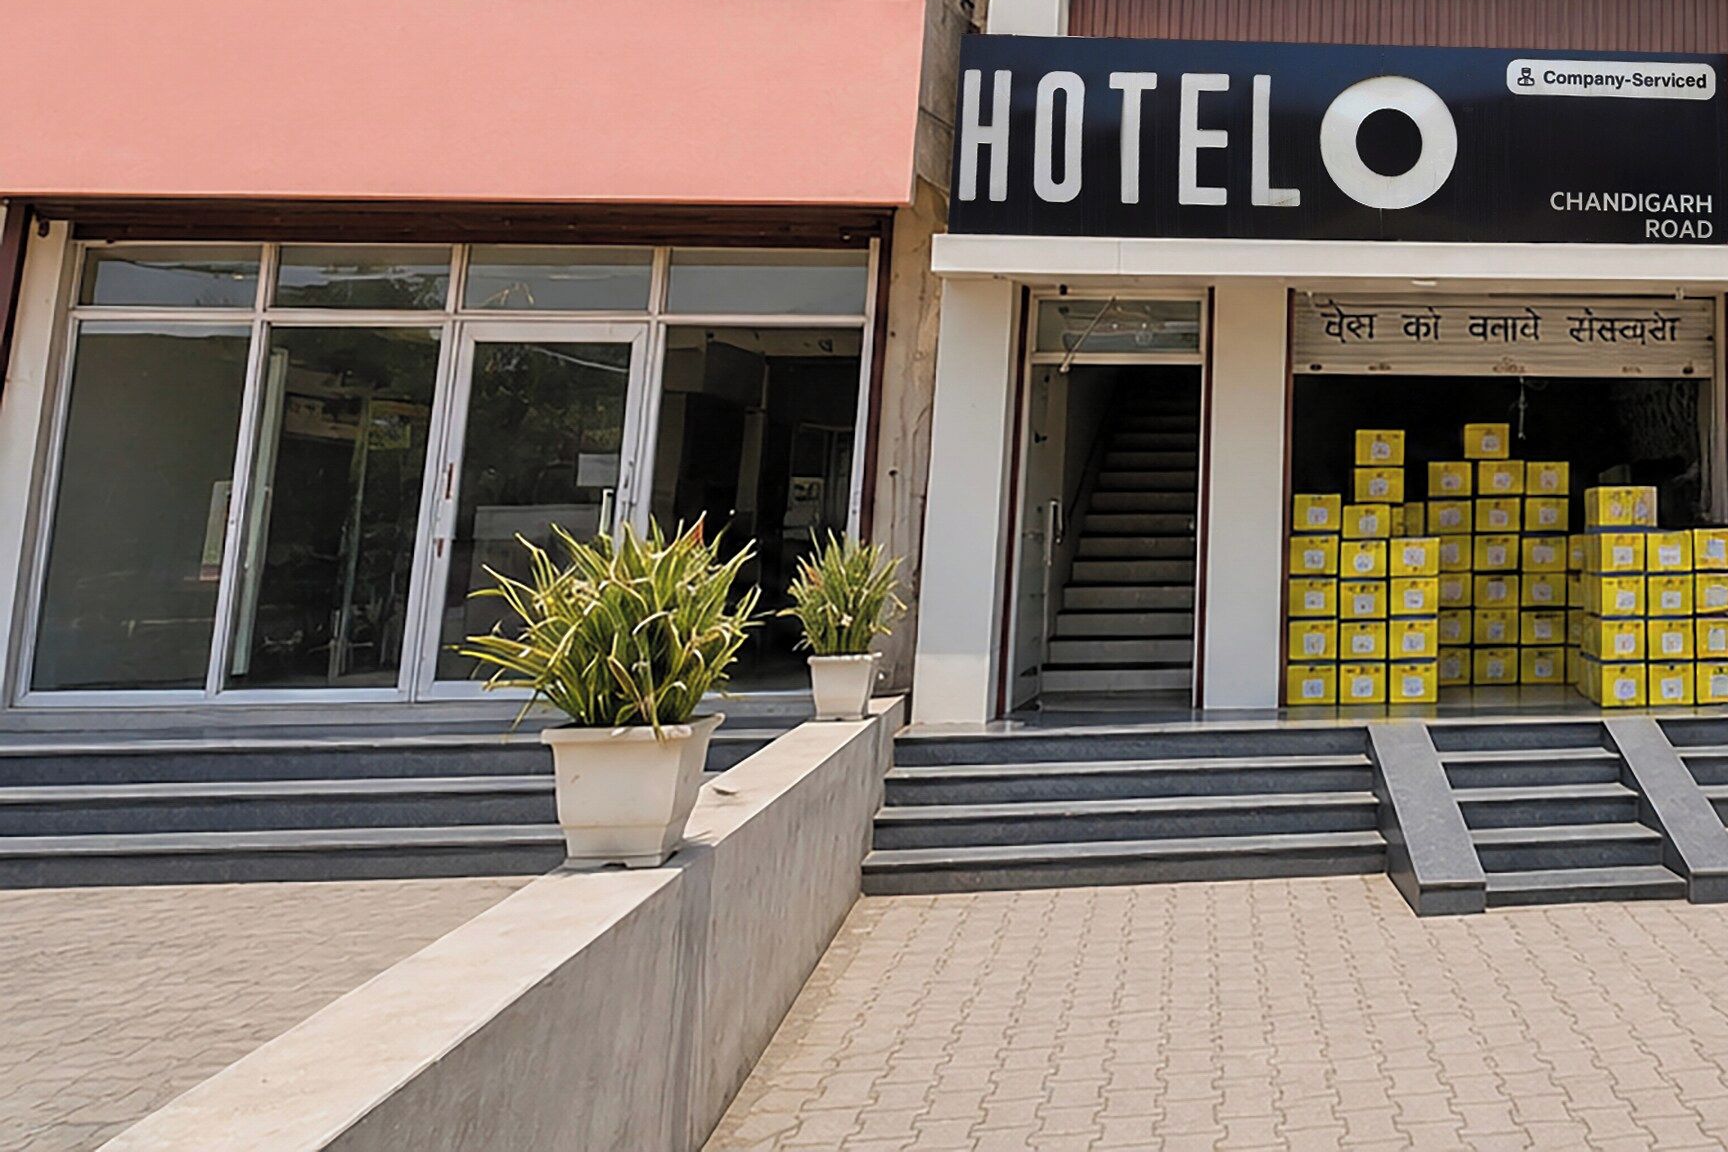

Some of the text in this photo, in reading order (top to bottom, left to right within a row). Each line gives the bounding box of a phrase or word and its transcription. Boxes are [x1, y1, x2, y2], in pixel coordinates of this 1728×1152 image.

[1543, 69, 1707, 90] Company-Serviced
[959, 69, 1458, 210] HOTEL O
[1550, 191, 1713, 214] CHANDIGARH
[1645, 219, 1713, 239] ROAD
[1402, 307, 1441, 341] को
